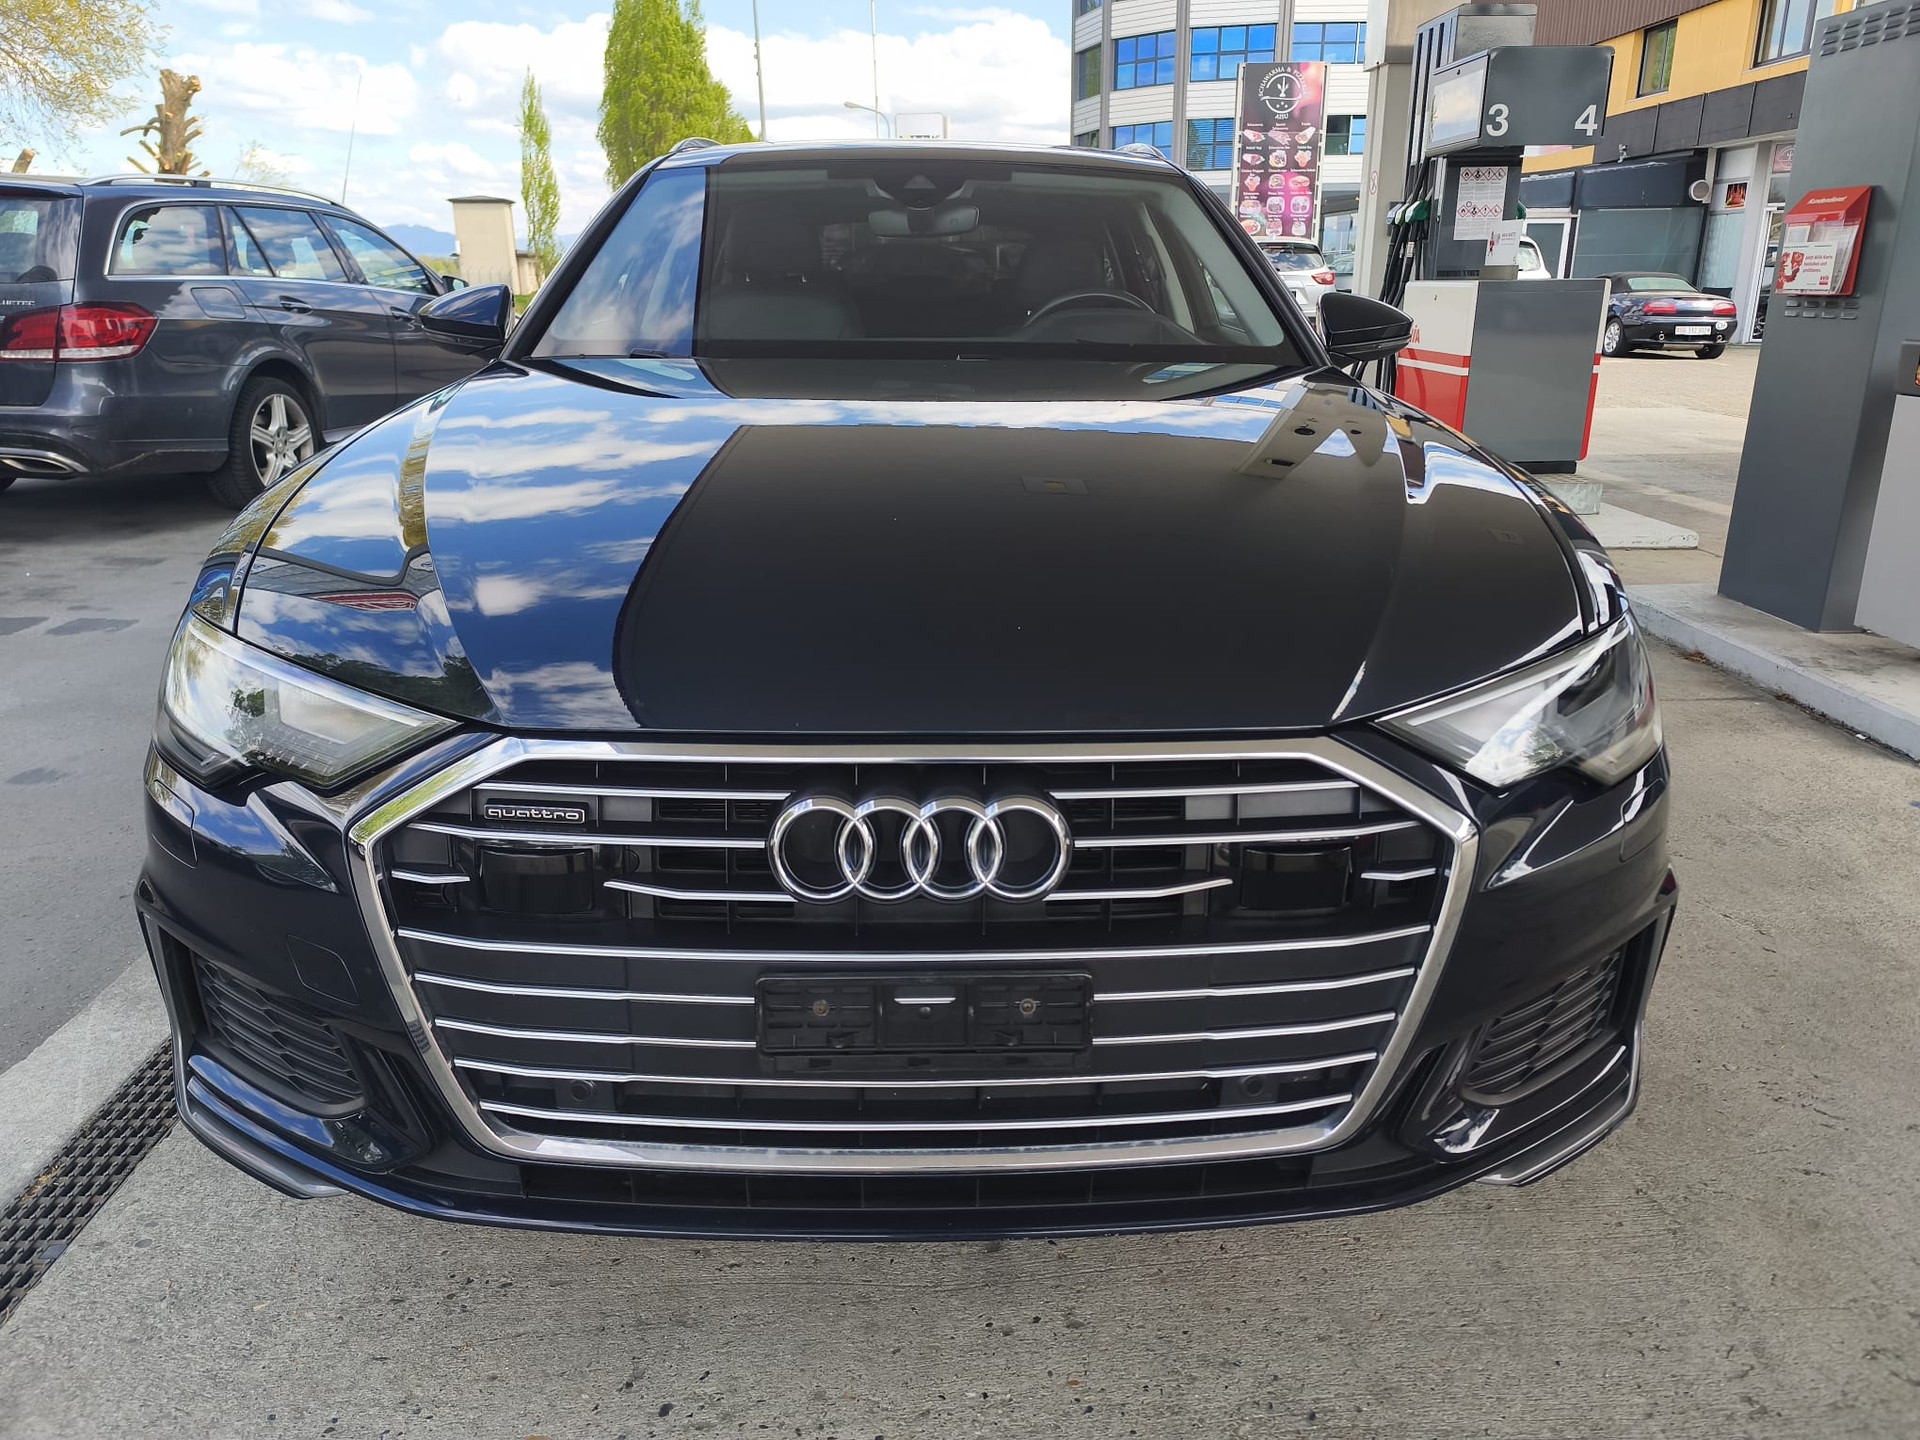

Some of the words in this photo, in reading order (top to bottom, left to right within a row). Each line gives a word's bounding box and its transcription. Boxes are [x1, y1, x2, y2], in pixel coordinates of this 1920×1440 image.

[1486, 103, 1509, 137] 3
[1574, 104, 1598, 136] 4
[488, 808, 579, 820] quattro
